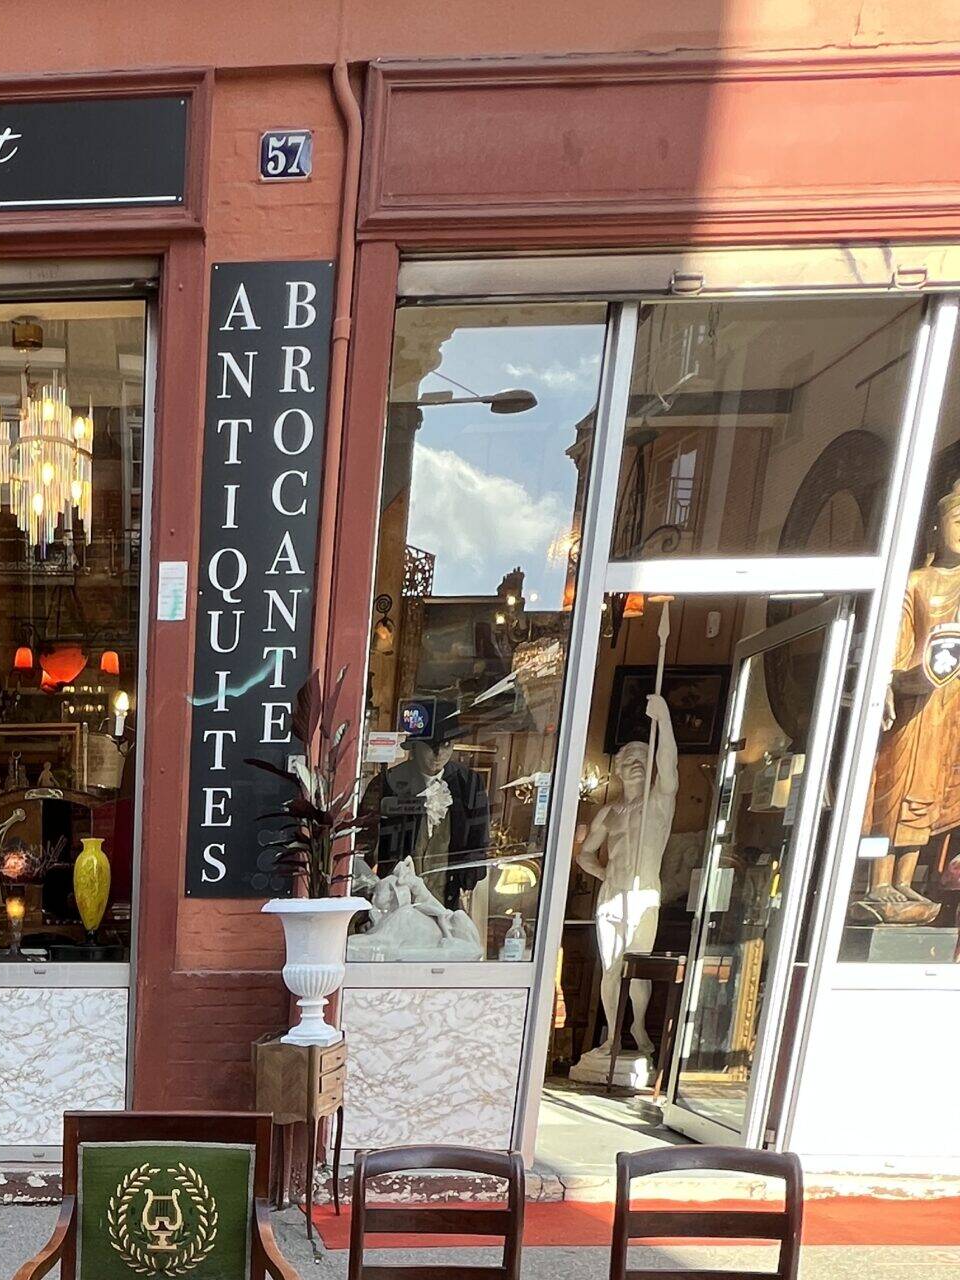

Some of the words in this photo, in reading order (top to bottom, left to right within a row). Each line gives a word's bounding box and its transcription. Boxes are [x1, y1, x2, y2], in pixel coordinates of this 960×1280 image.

[267, 135, 306, 175] 57
[200, 282, 262, 883] ANTIQUITES
[259, 280, 317, 743] BROCANTE
